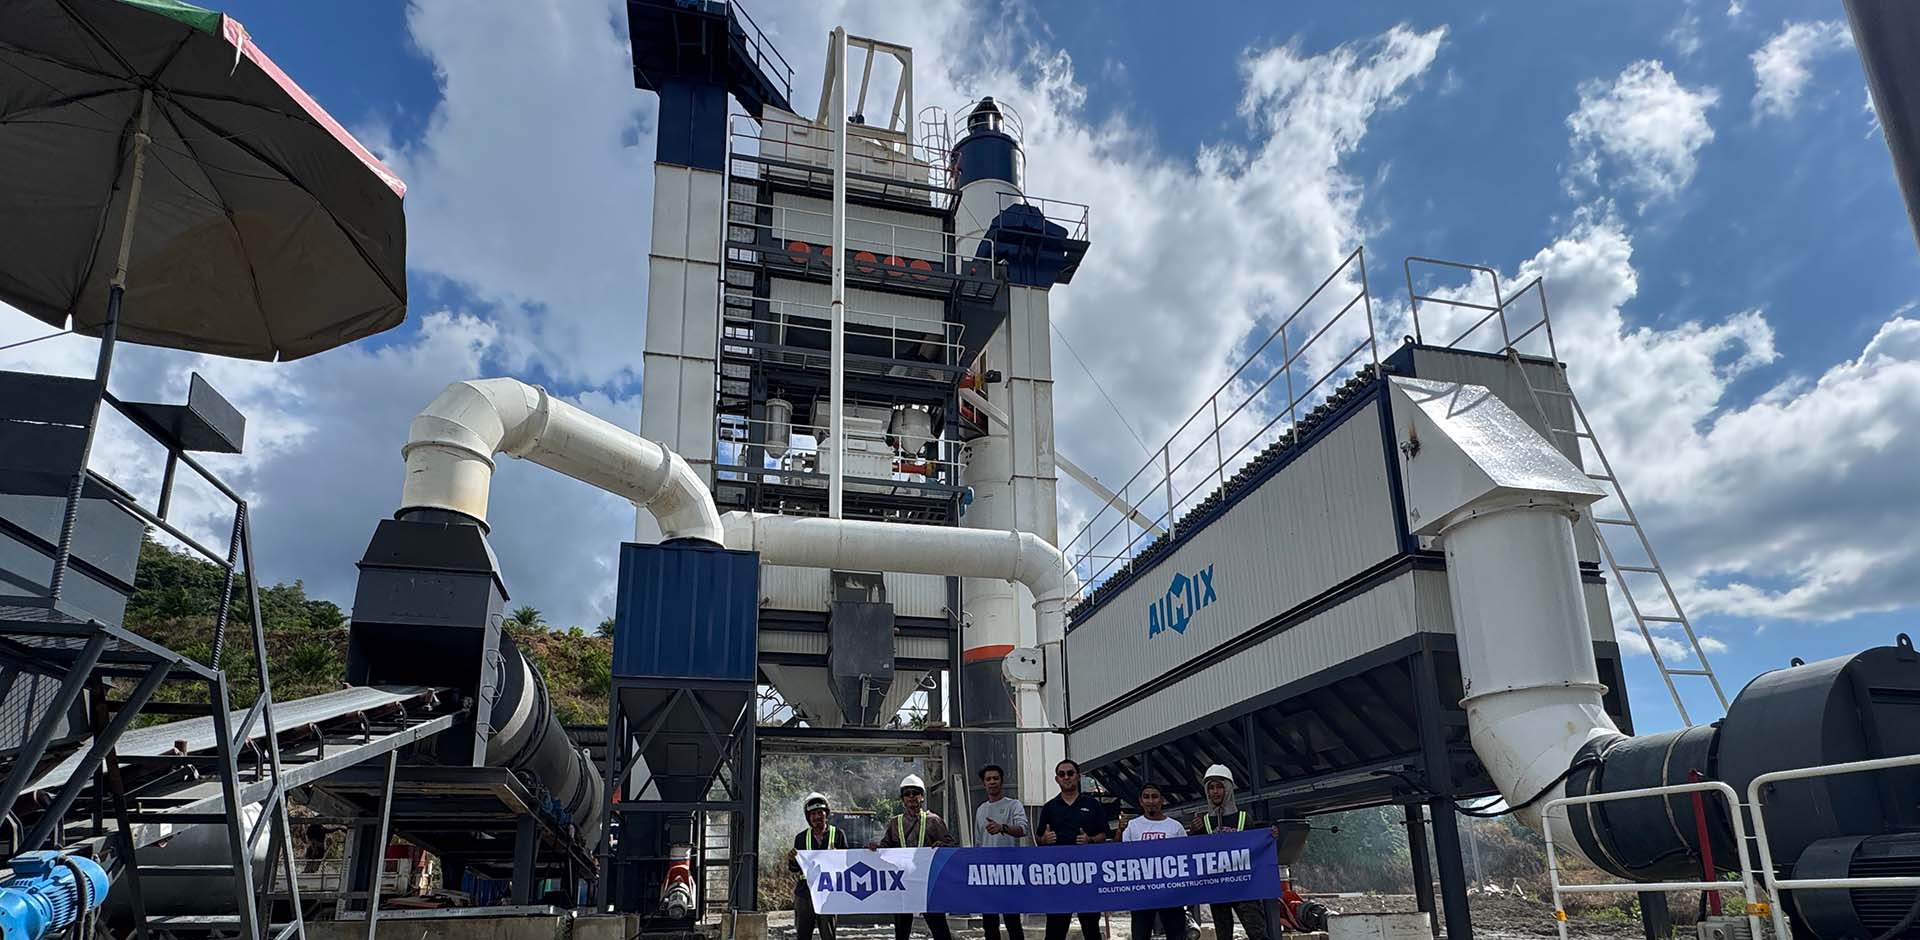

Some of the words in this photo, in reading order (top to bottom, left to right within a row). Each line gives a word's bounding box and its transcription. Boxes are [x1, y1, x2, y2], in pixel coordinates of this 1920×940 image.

[1148, 564, 1216, 639] AIMIX
[817, 864, 906, 899] AIMIX
[968, 864, 1025, 886] AIMIX
[1029, 862, 1097, 886] GROUP
[1101, 855, 1189, 883] SERVICE
[1193, 848, 1251, 876] TEAM
[1098, 886, 1131, 894] SOLUTION
[1166, 878, 1219, 889] CONSTRUCTION
[1220, 874, 1252, 884] PROJECT
